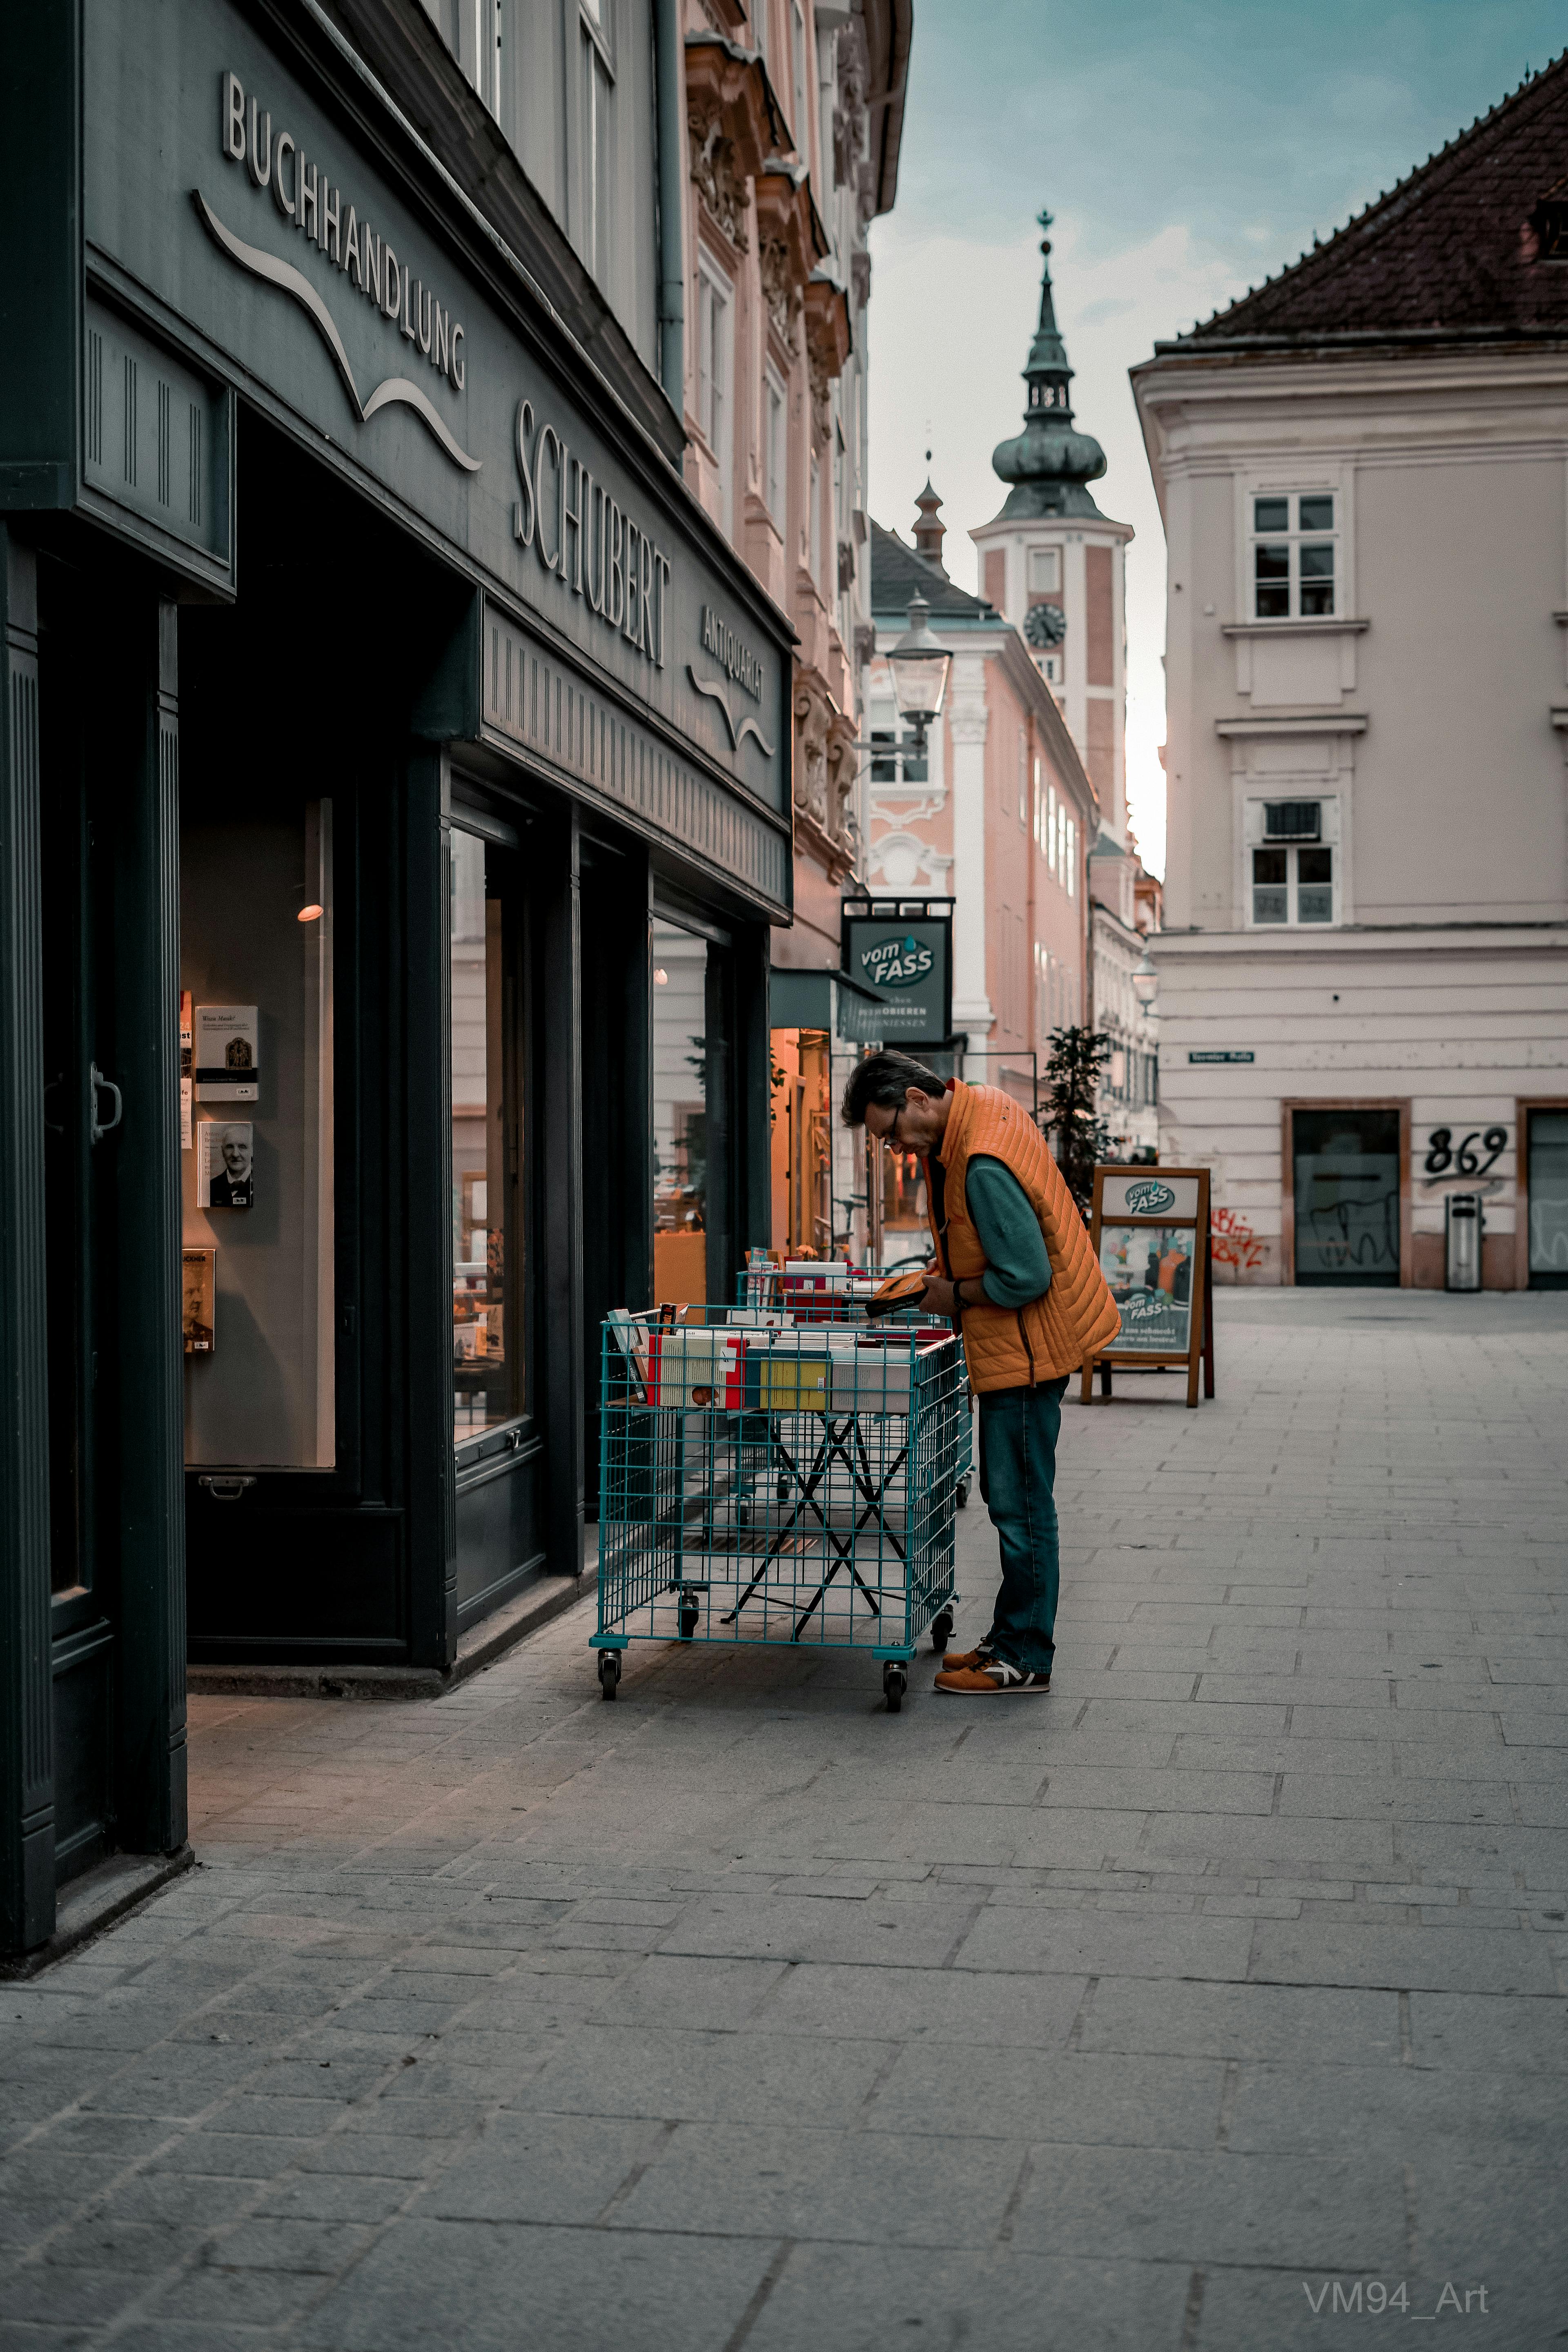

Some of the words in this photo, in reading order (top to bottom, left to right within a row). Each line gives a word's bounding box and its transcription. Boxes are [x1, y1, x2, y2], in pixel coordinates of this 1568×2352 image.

[223, 70, 465, 390] BUCHHANDLUNG
[514, 399, 670, 669] SCHUBERT
[701, 605, 762, 704] ANTIQUARIAT
[862, 943, 899, 966] vom
[875, 950, 932, 983] FASS
[1425, 1126, 1508, 1176] 869
[1129, 1185, 1151, 1200] vom
[1129, 1186, 1168, 1214] FASS
[1131, 1303, 1162, 1320] FASS
